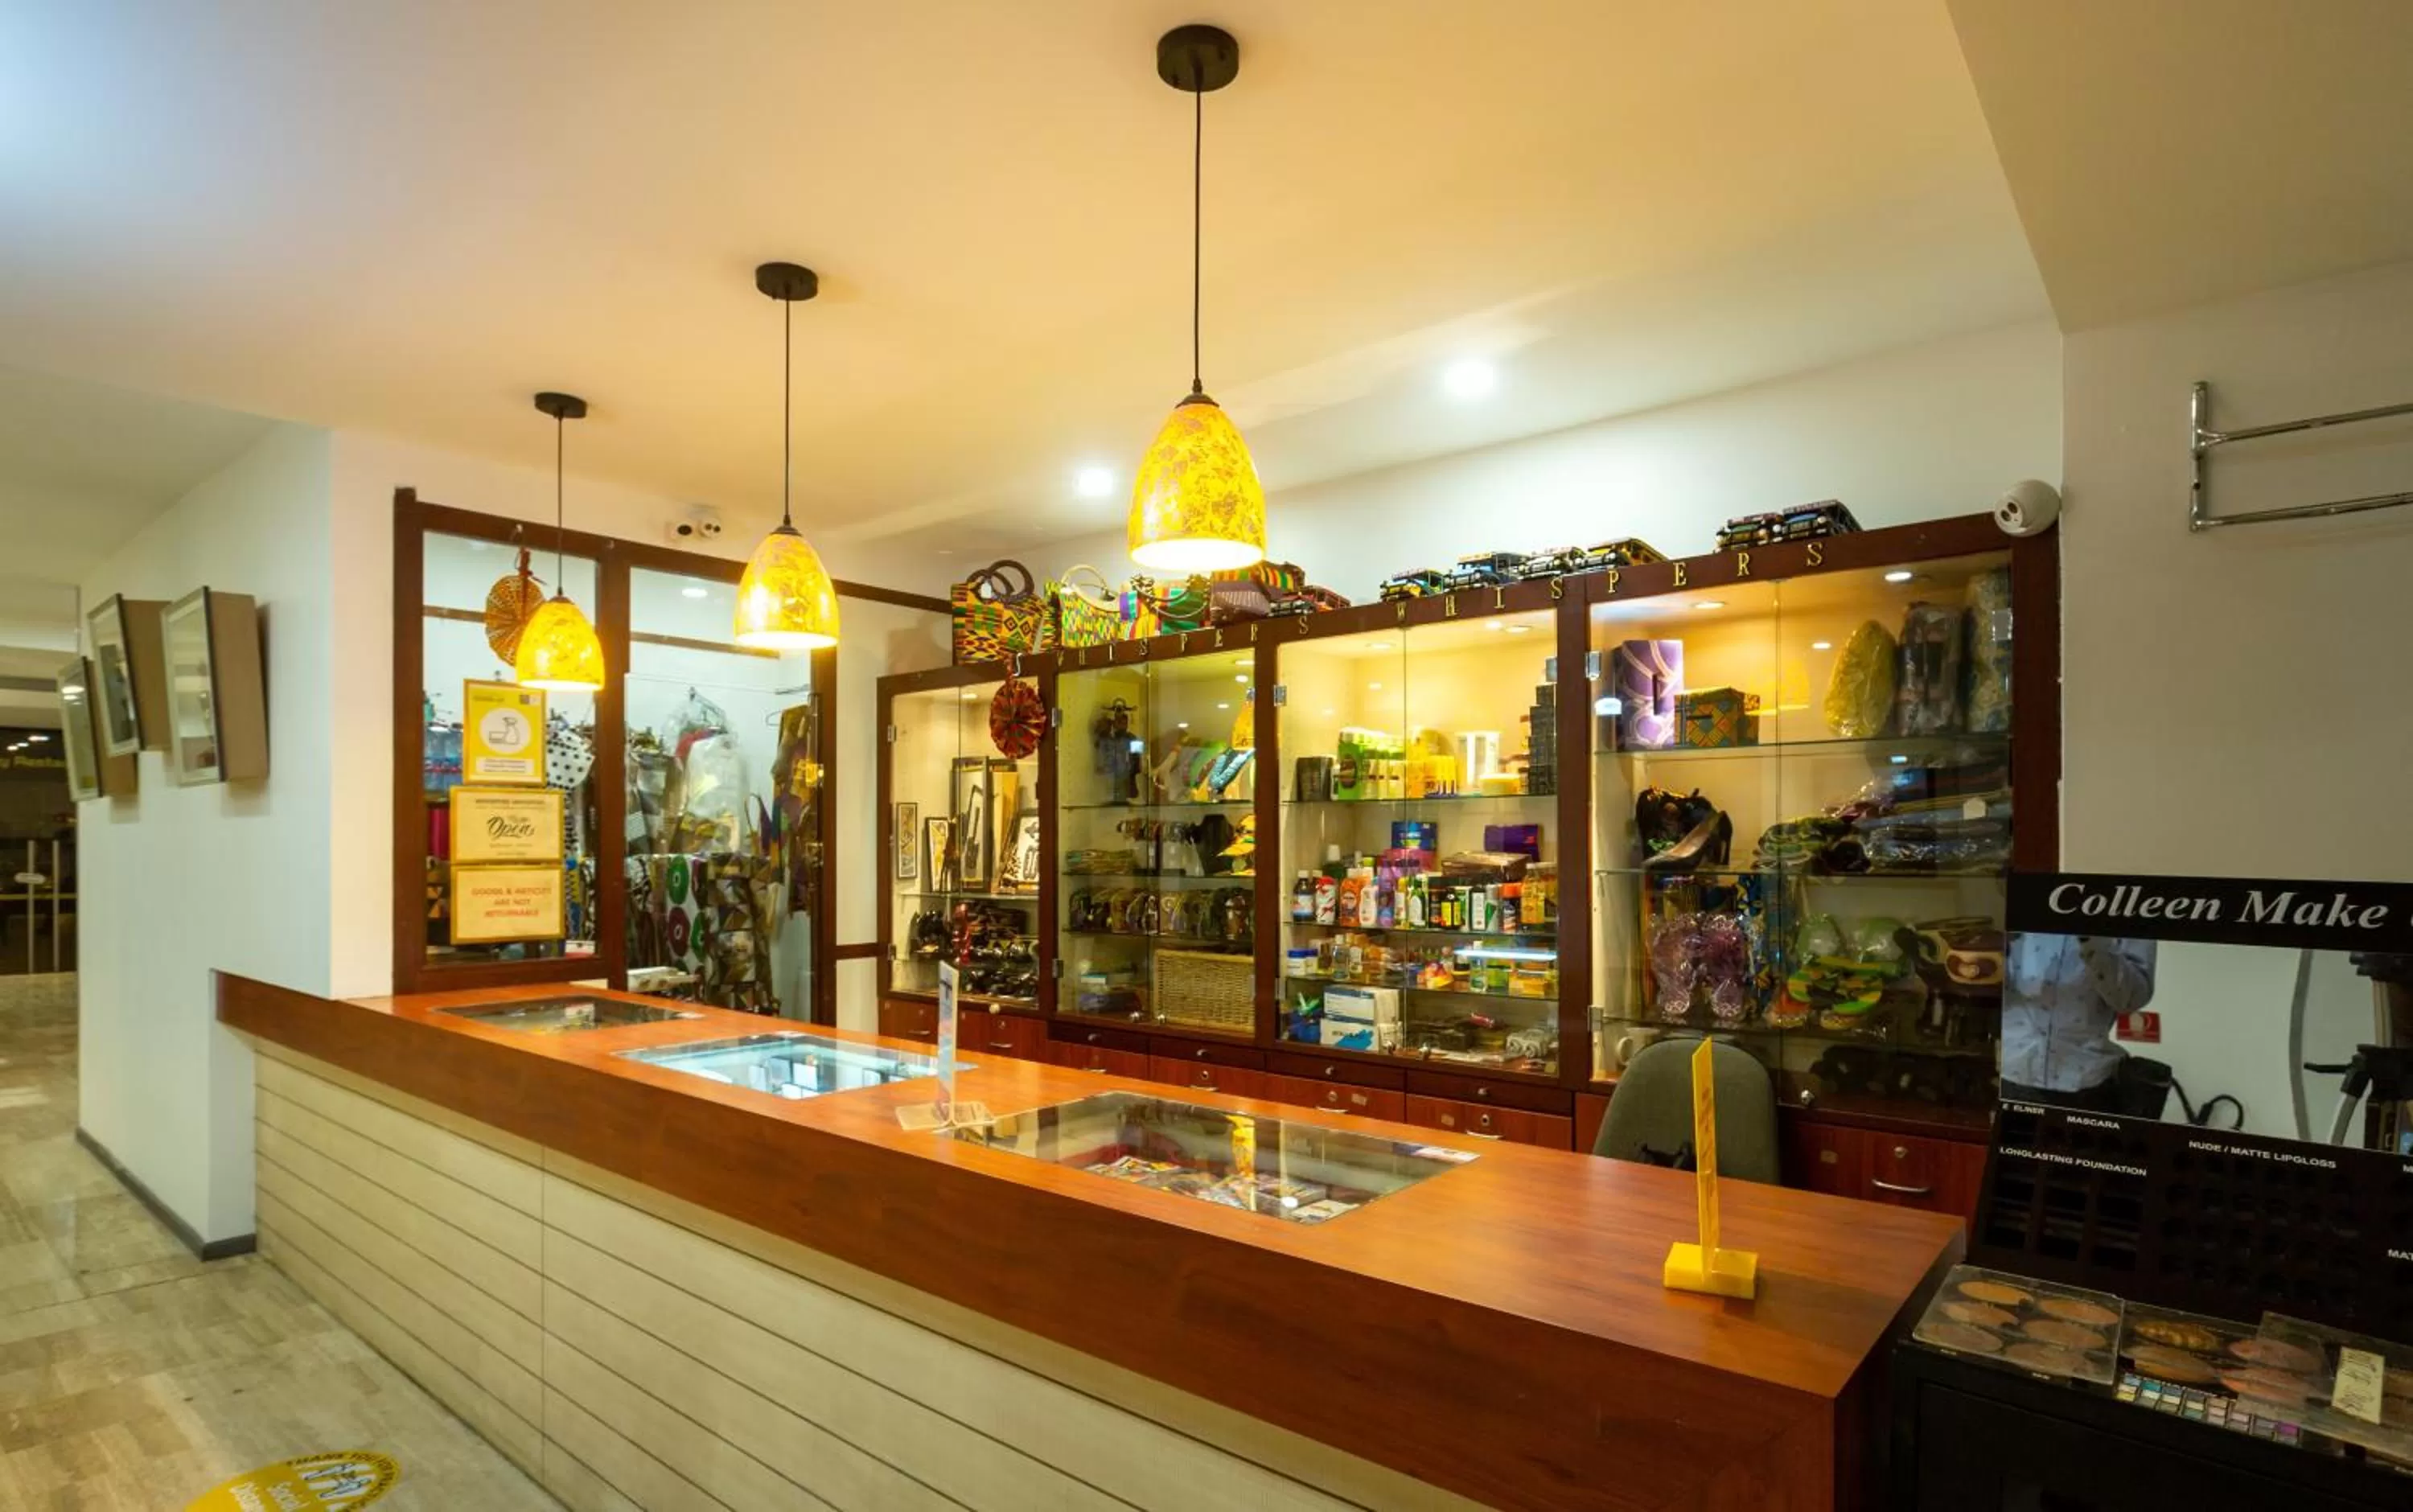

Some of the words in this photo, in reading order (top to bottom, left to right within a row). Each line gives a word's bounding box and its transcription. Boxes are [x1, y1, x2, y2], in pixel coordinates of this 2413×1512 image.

[1397, 541, 1824, 622] WHISPERS
[2049, 883, 2221, 921] Colleen
[2237, 890, 2389, 929] Make
[2066, 1115, 2120, 1130] MASCARA
[1999, 1146, 2074, 1165] LONGLASTING
[2074, 1157, 2148, 1177] FOUNDATION
[2189, 1140, 2222, 1152] NUDE
[2230, 1146, 2271, 1159] MATTE
[2274, 1153, 2337, 1169] LIPGLOSS
